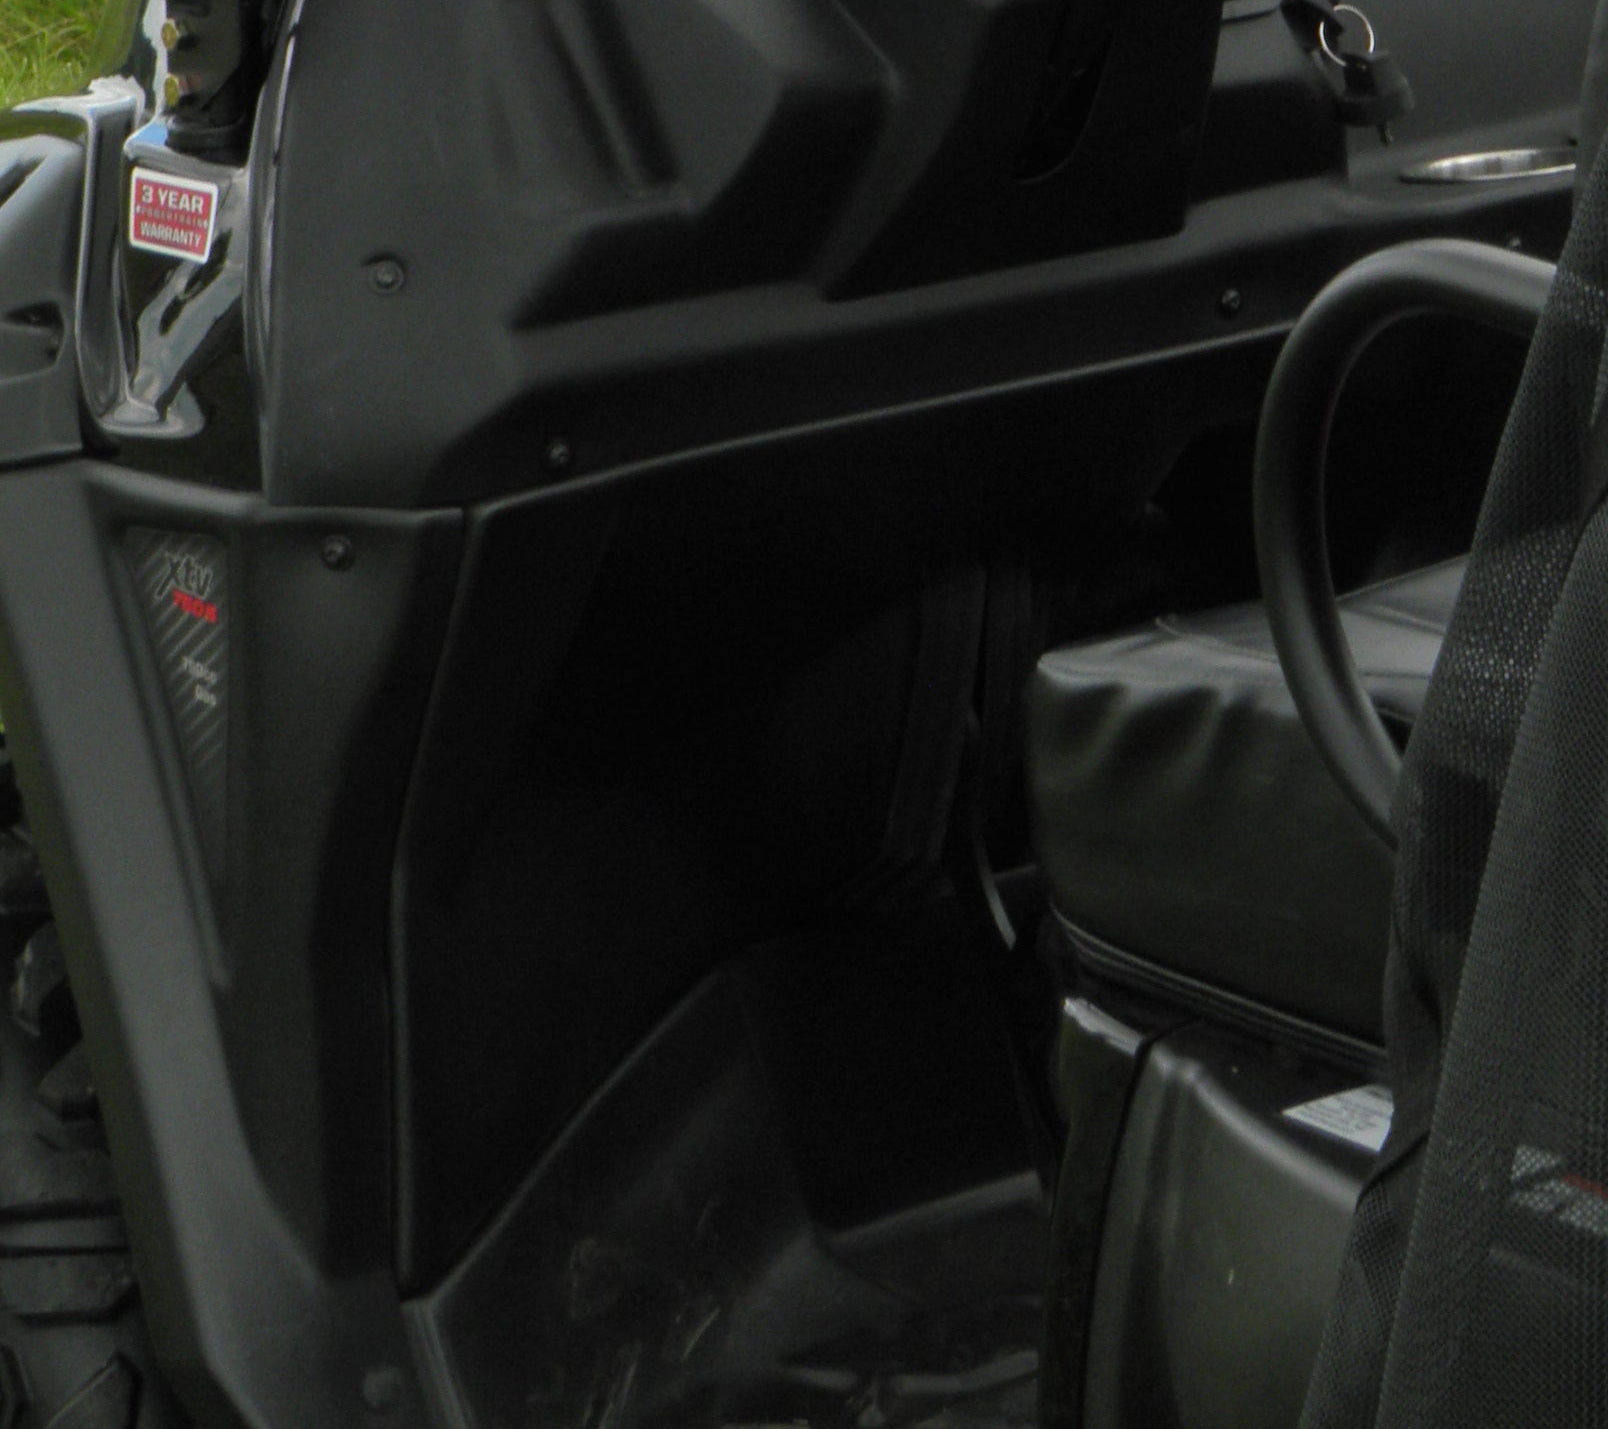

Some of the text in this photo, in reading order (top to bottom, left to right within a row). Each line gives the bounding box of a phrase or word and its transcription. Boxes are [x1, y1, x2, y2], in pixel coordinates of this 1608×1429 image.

[141, 184, 205, 214] 3 YEAR
[140, 221, 202, 248] WARRANTY
